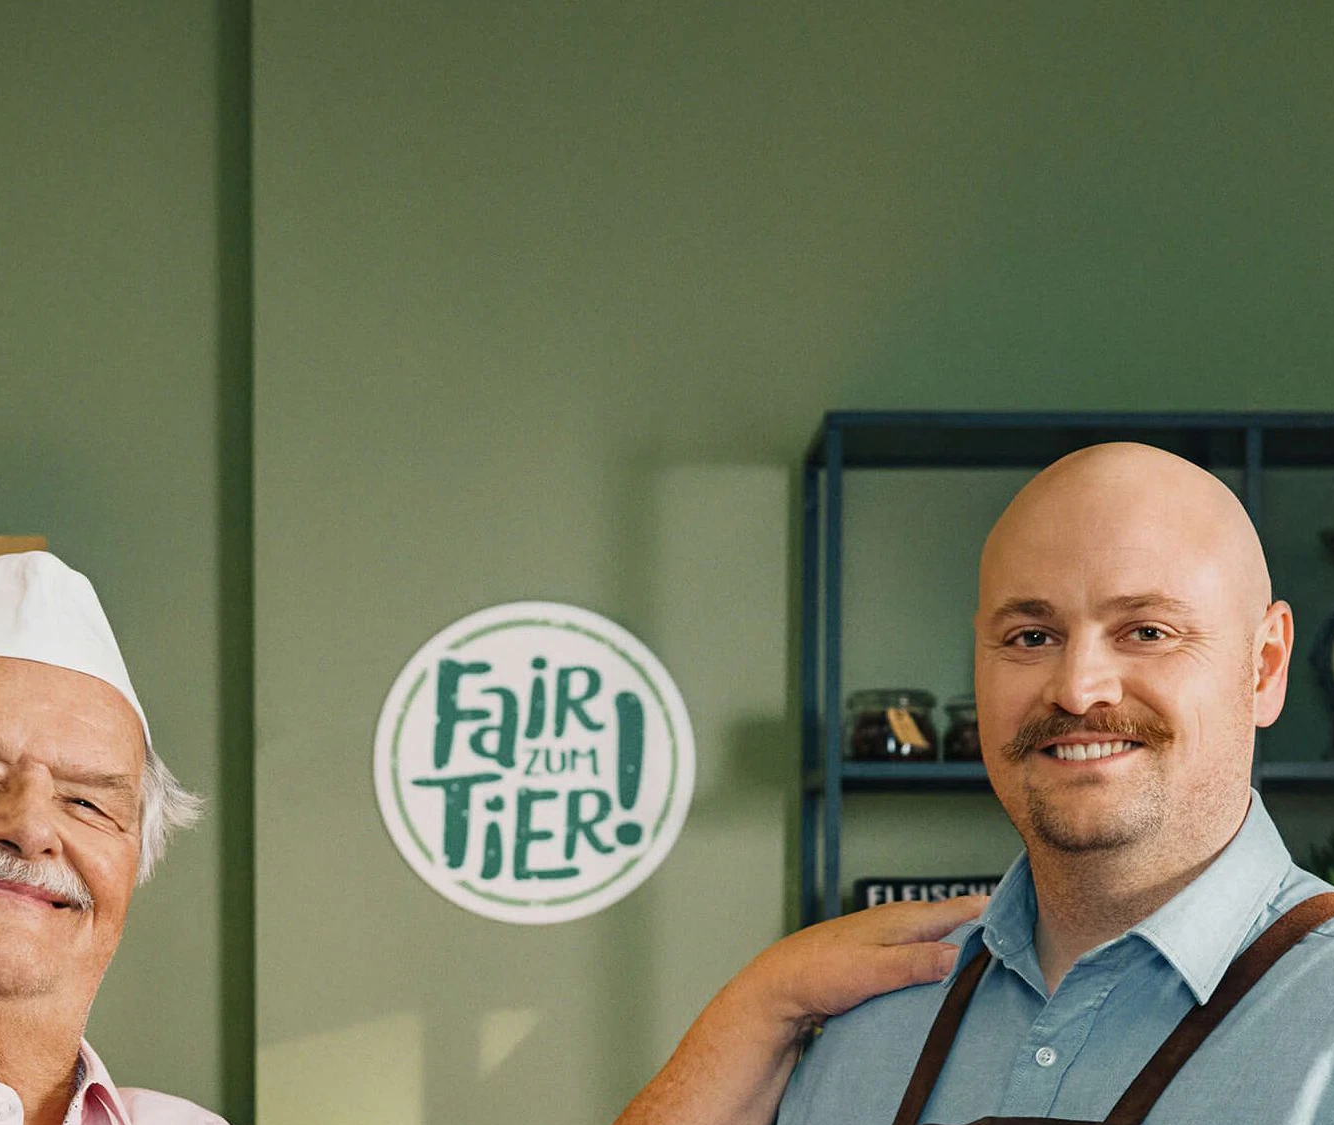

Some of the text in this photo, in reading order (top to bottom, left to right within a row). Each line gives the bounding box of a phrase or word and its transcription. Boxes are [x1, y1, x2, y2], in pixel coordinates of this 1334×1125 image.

[433, 657, 605, 770] FaiR
[523, 748, 600, 777] ZUM
[867, 883, 997, 908] FLEISCH
